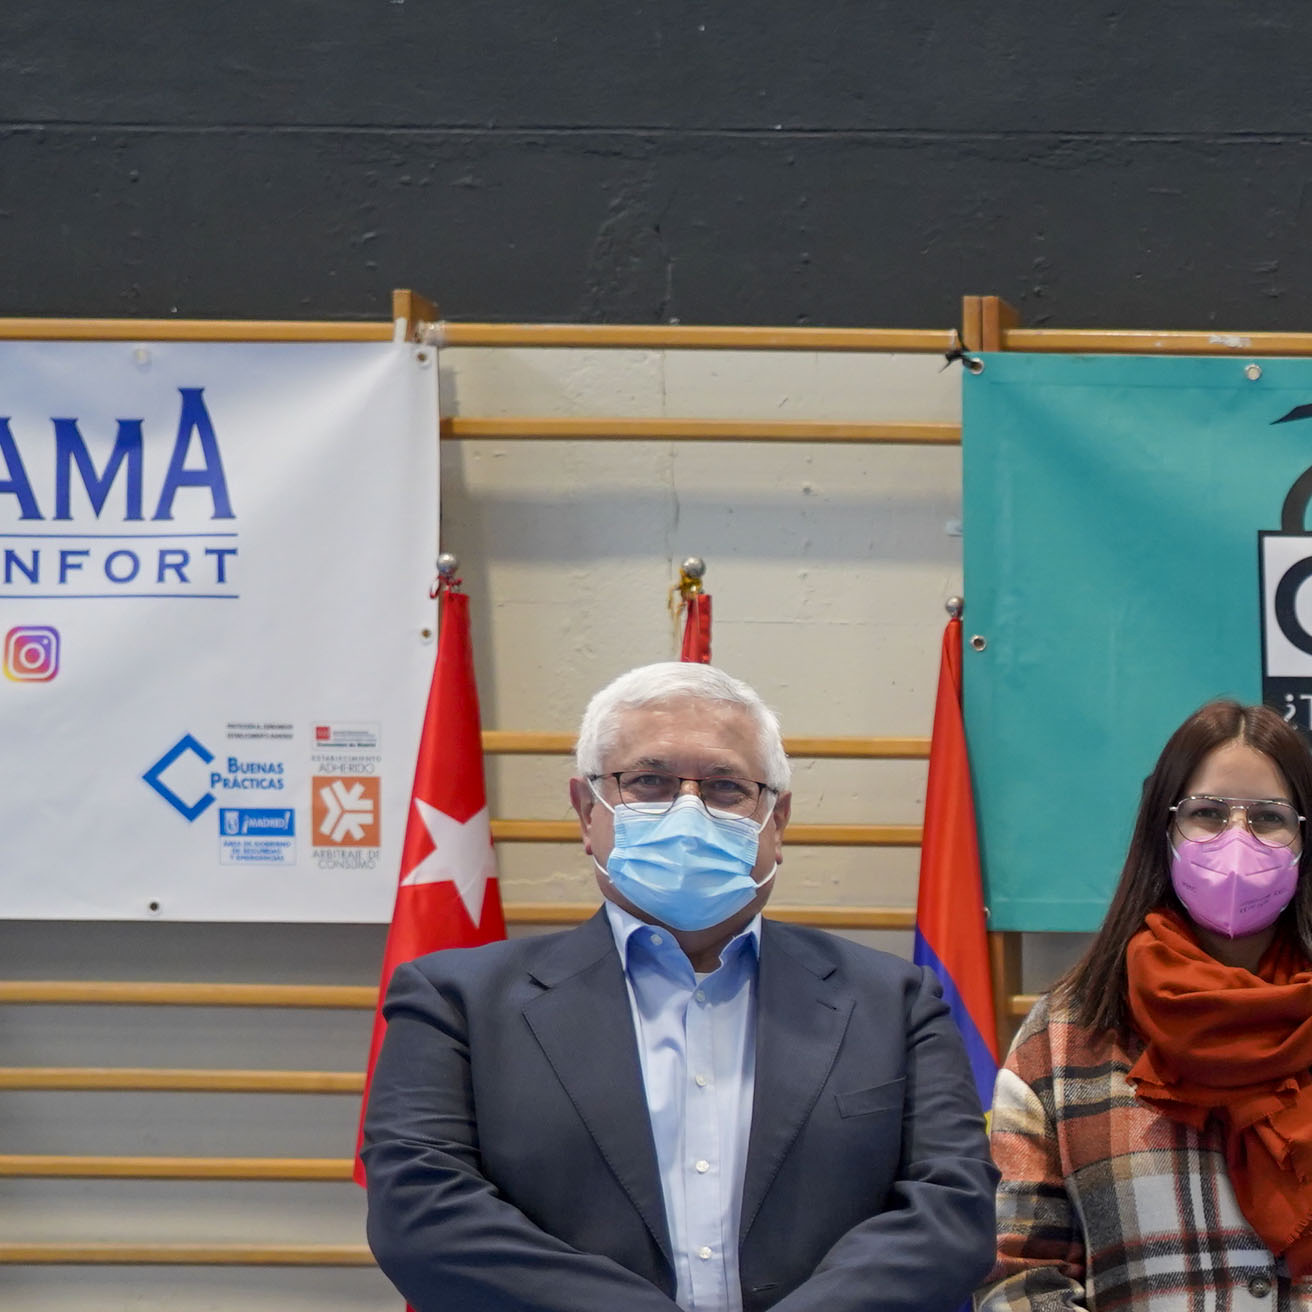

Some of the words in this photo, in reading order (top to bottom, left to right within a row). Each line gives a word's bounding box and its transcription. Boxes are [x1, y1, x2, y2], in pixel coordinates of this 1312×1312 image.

[2, 547, 239, 585] NFORT
[227, 756, 285, 775] BUENAS
[210, 772, 285, 791] PRÁCTICAS
